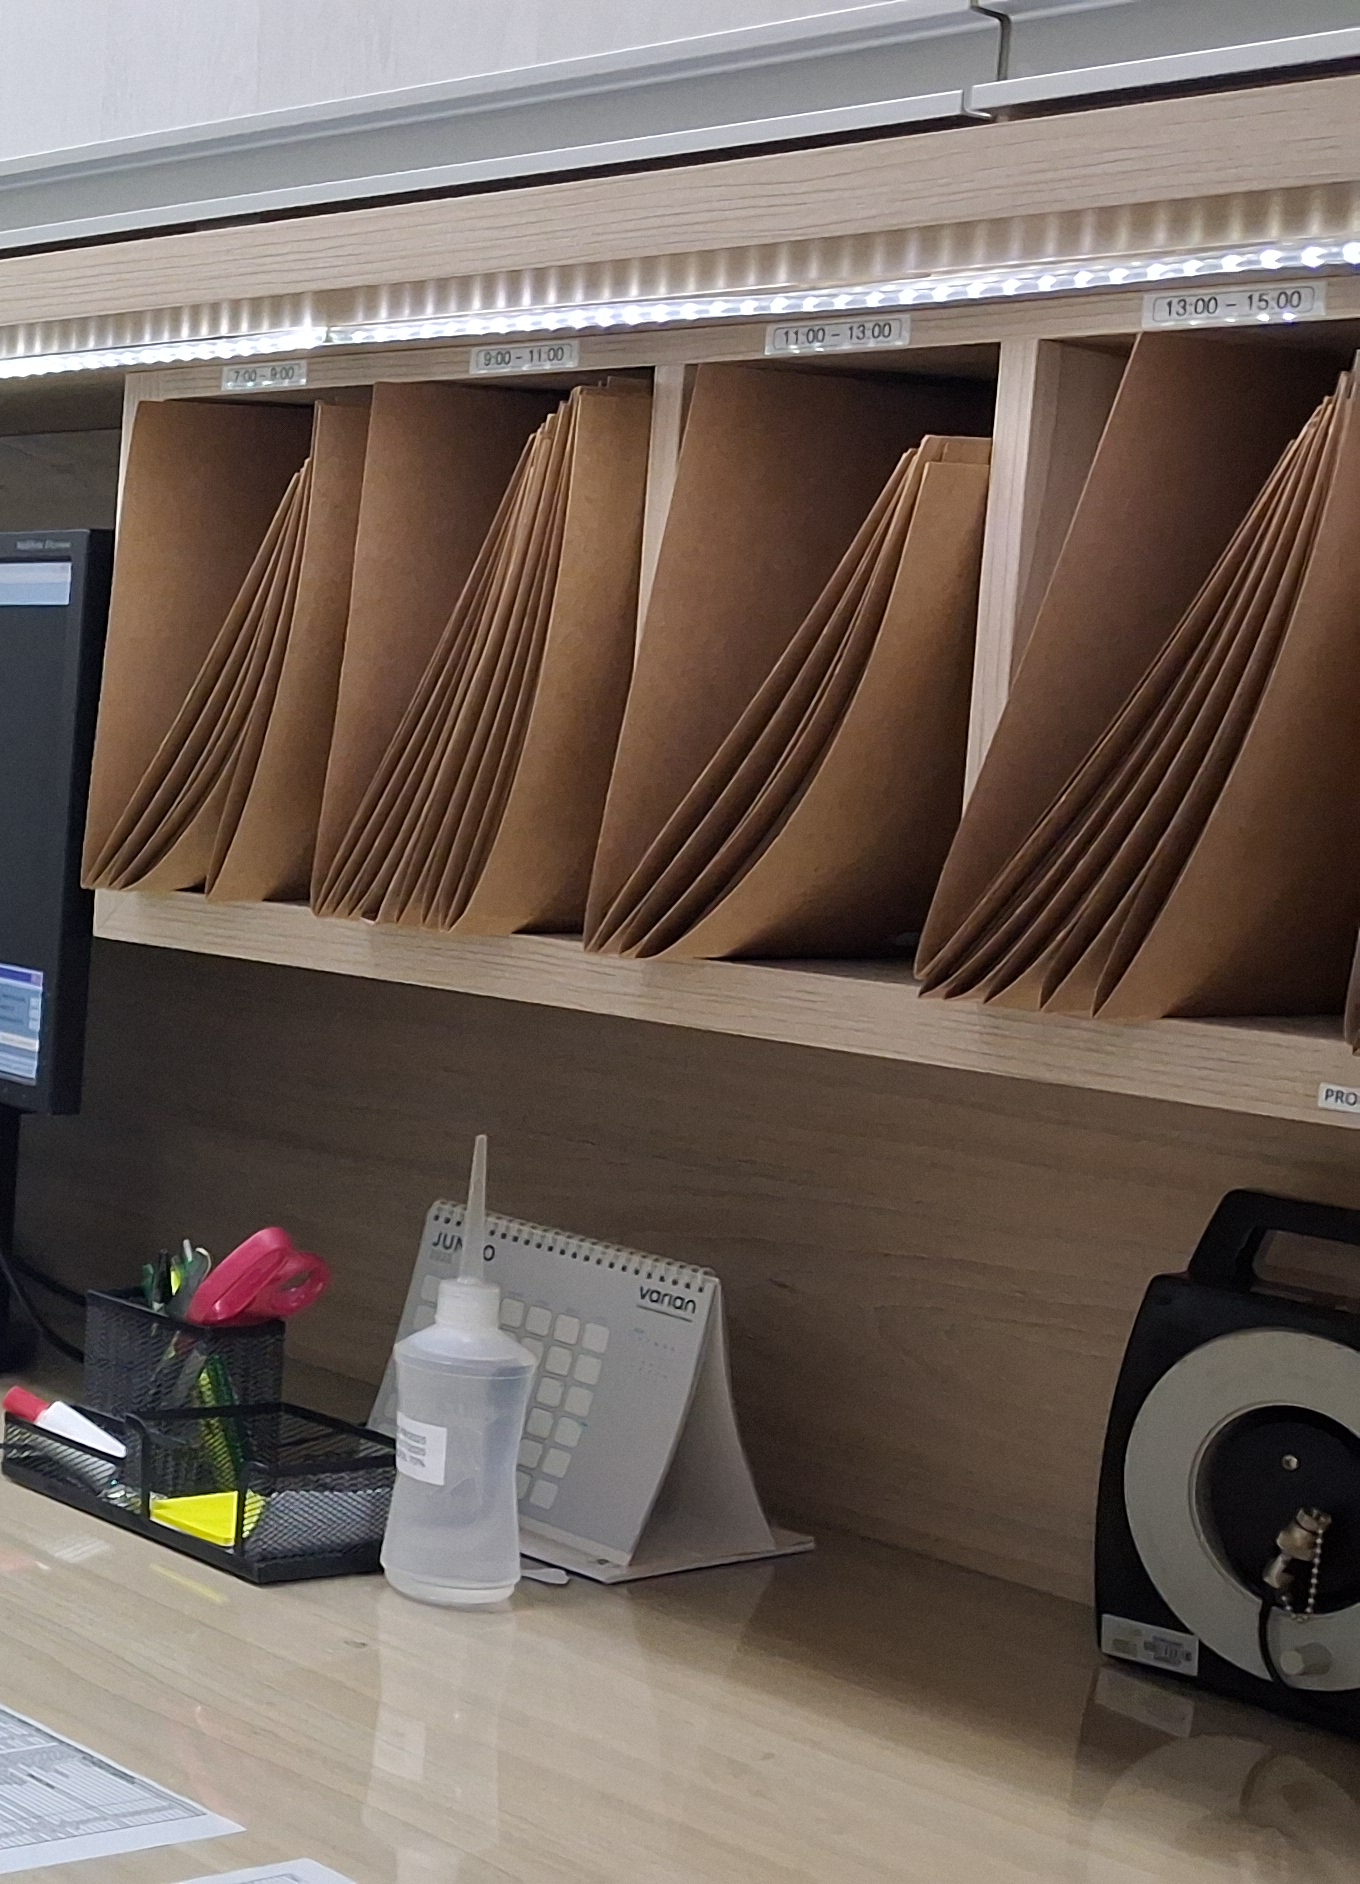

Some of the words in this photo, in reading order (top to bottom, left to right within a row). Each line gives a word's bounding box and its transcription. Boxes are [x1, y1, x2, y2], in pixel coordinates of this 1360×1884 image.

[1166, 296, 1219, 317] 13:00
[1247, 289, 1302, 311] 15:00
[783, 327, 826, 345] 11:00
[848, 322, 892, 341] 13:00
[431, 1231, 496, 1262] JUNO
